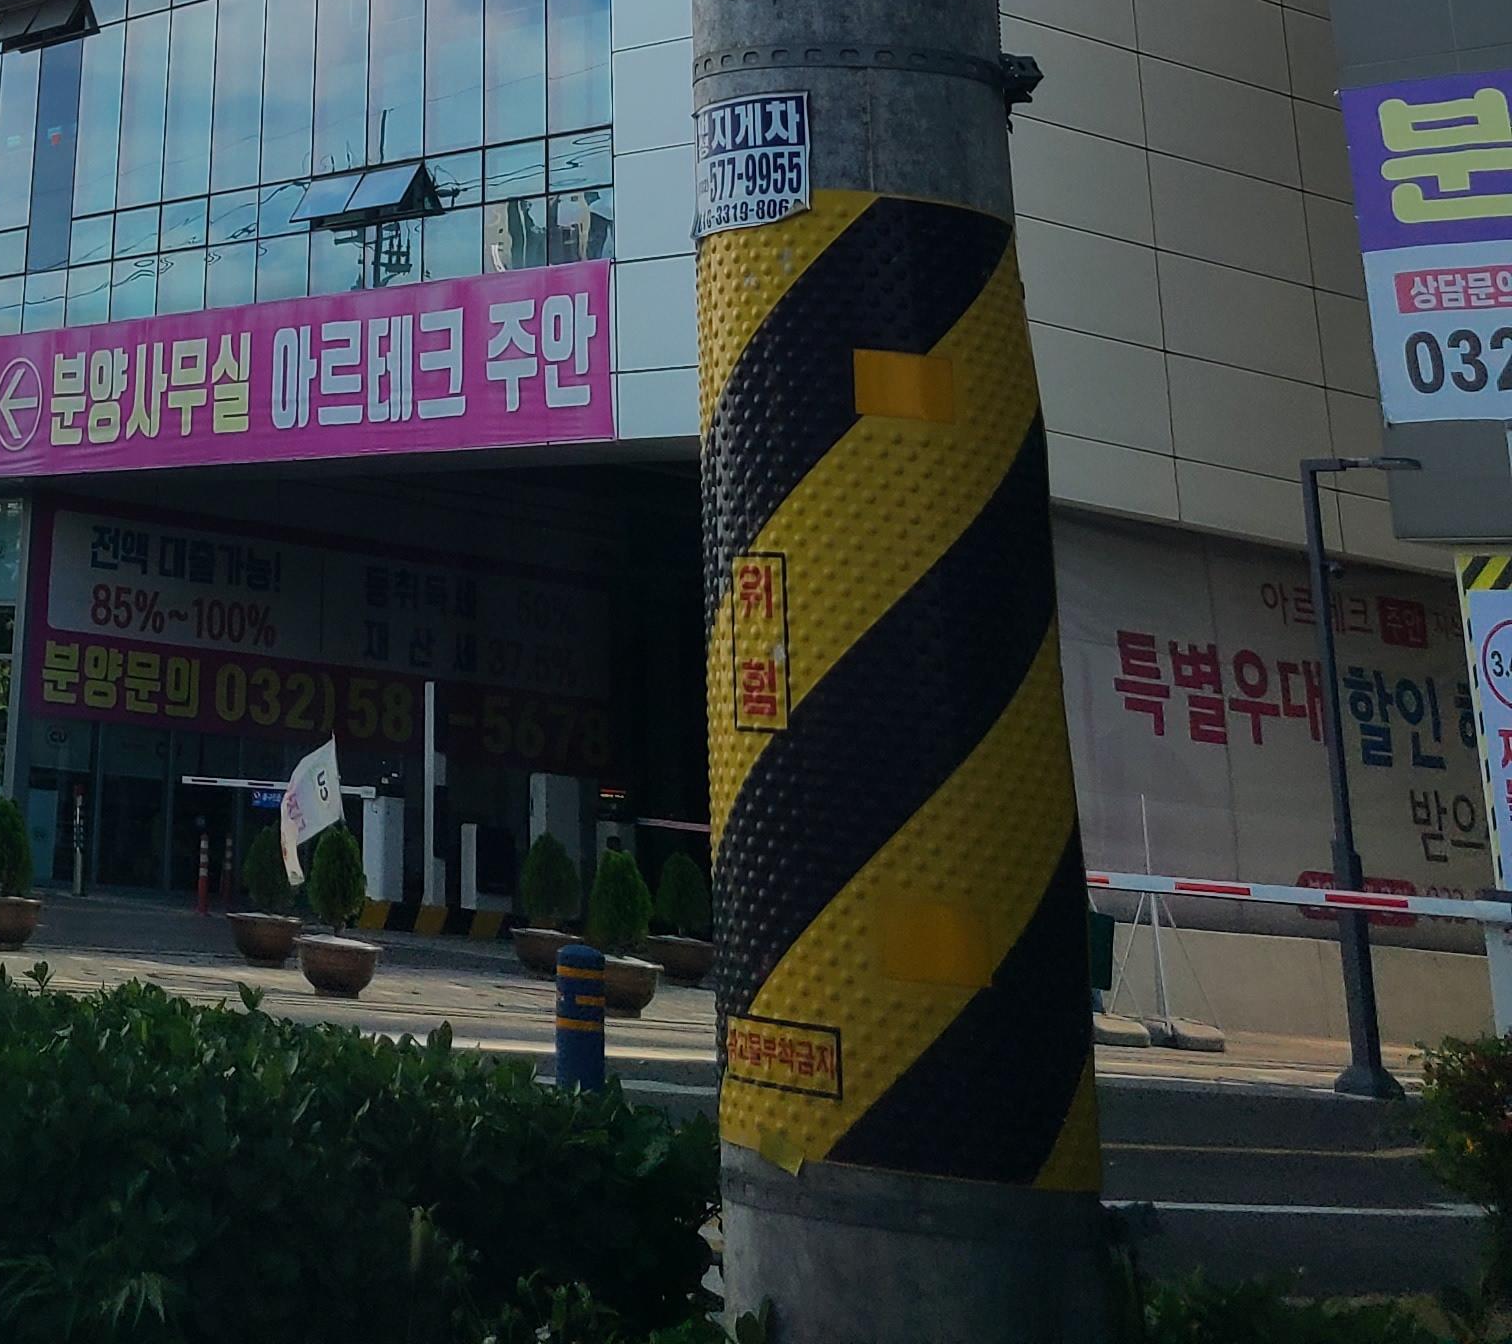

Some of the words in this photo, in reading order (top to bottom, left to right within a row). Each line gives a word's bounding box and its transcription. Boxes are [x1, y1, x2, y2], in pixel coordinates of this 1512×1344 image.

[709, 151, 803, 204] 577-9955
[48, 332, 252, 447] 분양사무실
[270, 306, 467, 430] 아르테크
[486, 293, 598, 413] 주안
[90, 582, 279, 649] 85%~100%
[739, 564, 777, 717] 위험
[42, 639, 201, 720] 분양문의
[1113, 628, 1329, 747] 특별우대
[1342, 665, 1448, 770] 할인
[1490, 649, 1512, 680] 3.
